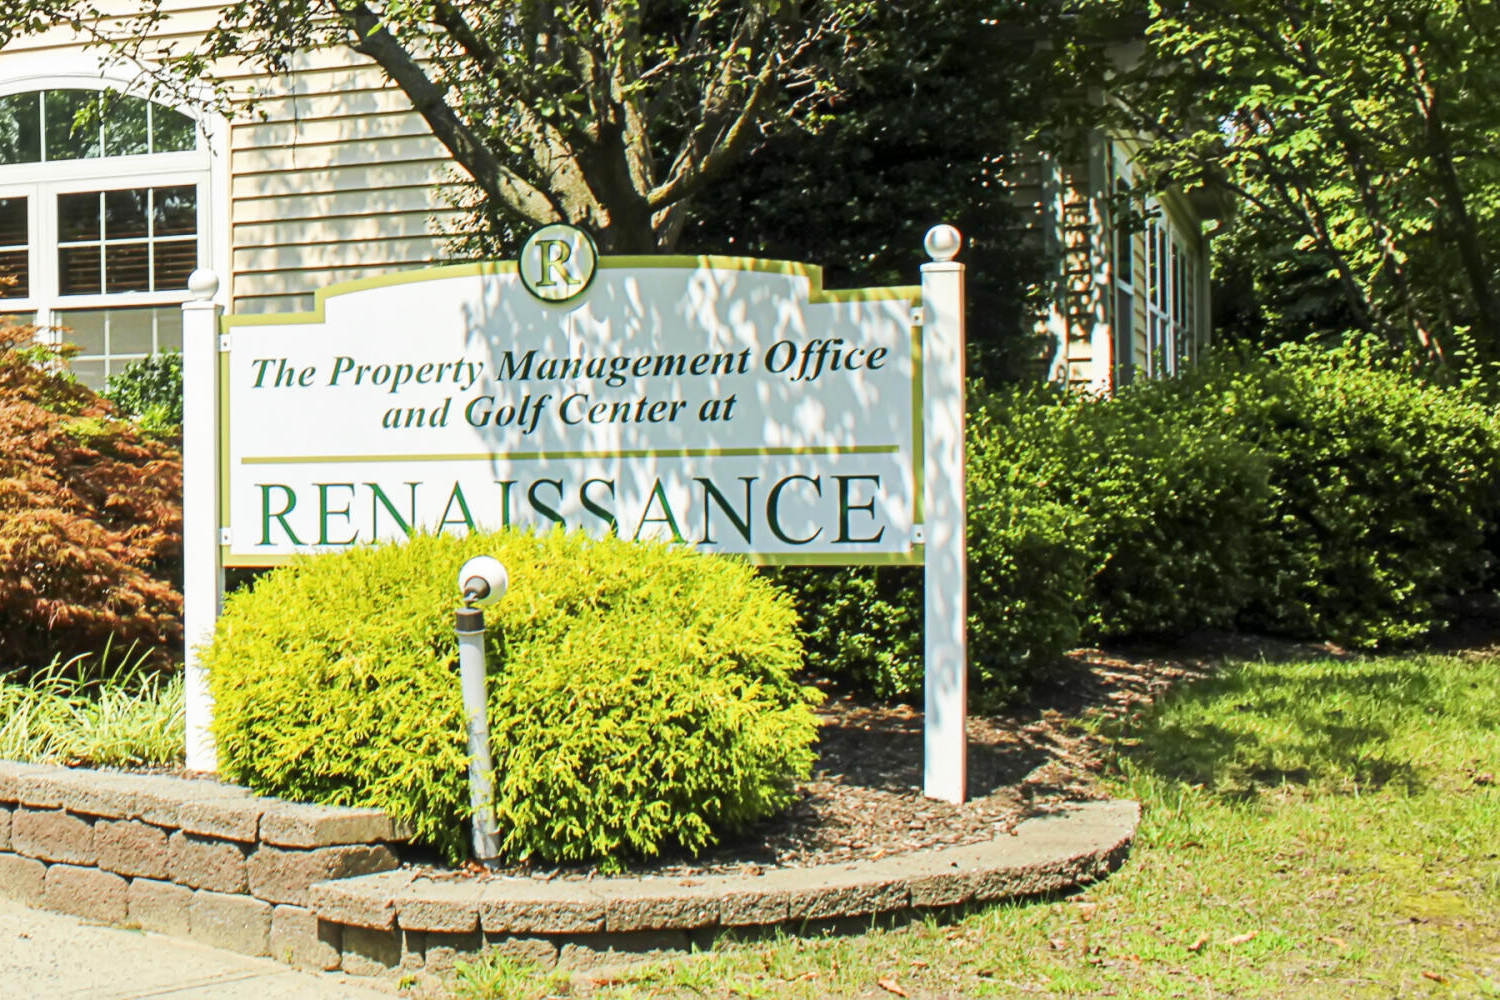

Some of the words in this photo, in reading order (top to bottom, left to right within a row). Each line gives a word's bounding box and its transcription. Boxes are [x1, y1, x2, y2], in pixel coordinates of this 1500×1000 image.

[534, 239, 582, 287] R
[251, 358, 317, 389] The
[326, 356, 484, 394] Property
[496, 346, 752, 388] Management
[764, 338, 889, 382] Office
[382, 397, 452, 429] and
[464, 394, 553, 435] Golf
[559, 393, 688, 426] Center
[698, 393, 738, 423] at
[254, 474, 886, 546] RENAISSANCE
